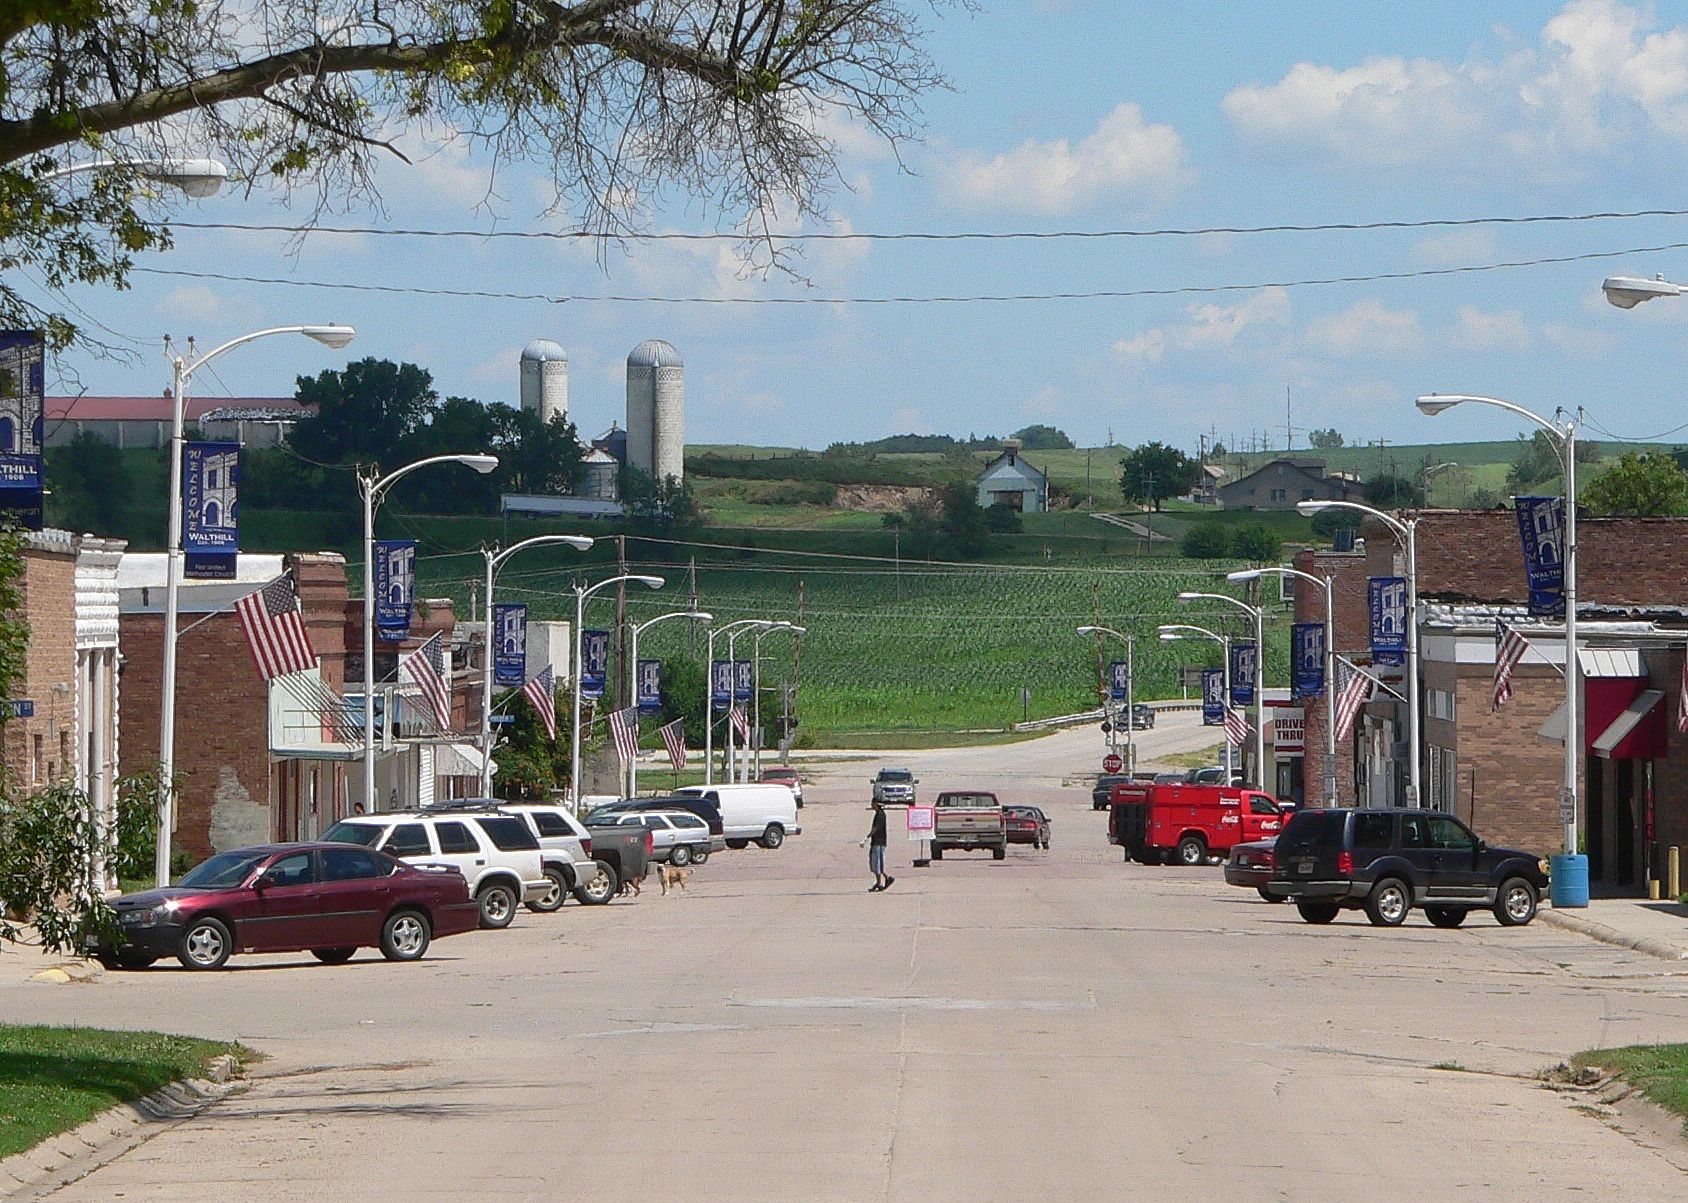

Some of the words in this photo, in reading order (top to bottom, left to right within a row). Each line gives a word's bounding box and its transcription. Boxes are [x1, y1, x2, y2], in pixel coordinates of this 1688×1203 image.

[188, 450, 201, 531] WELCOME
[1275, 719, 1306, 729] DRIVE
[1276, 730, 1303, 740] THRU
[1104, 760, 1121, 768] STOP
